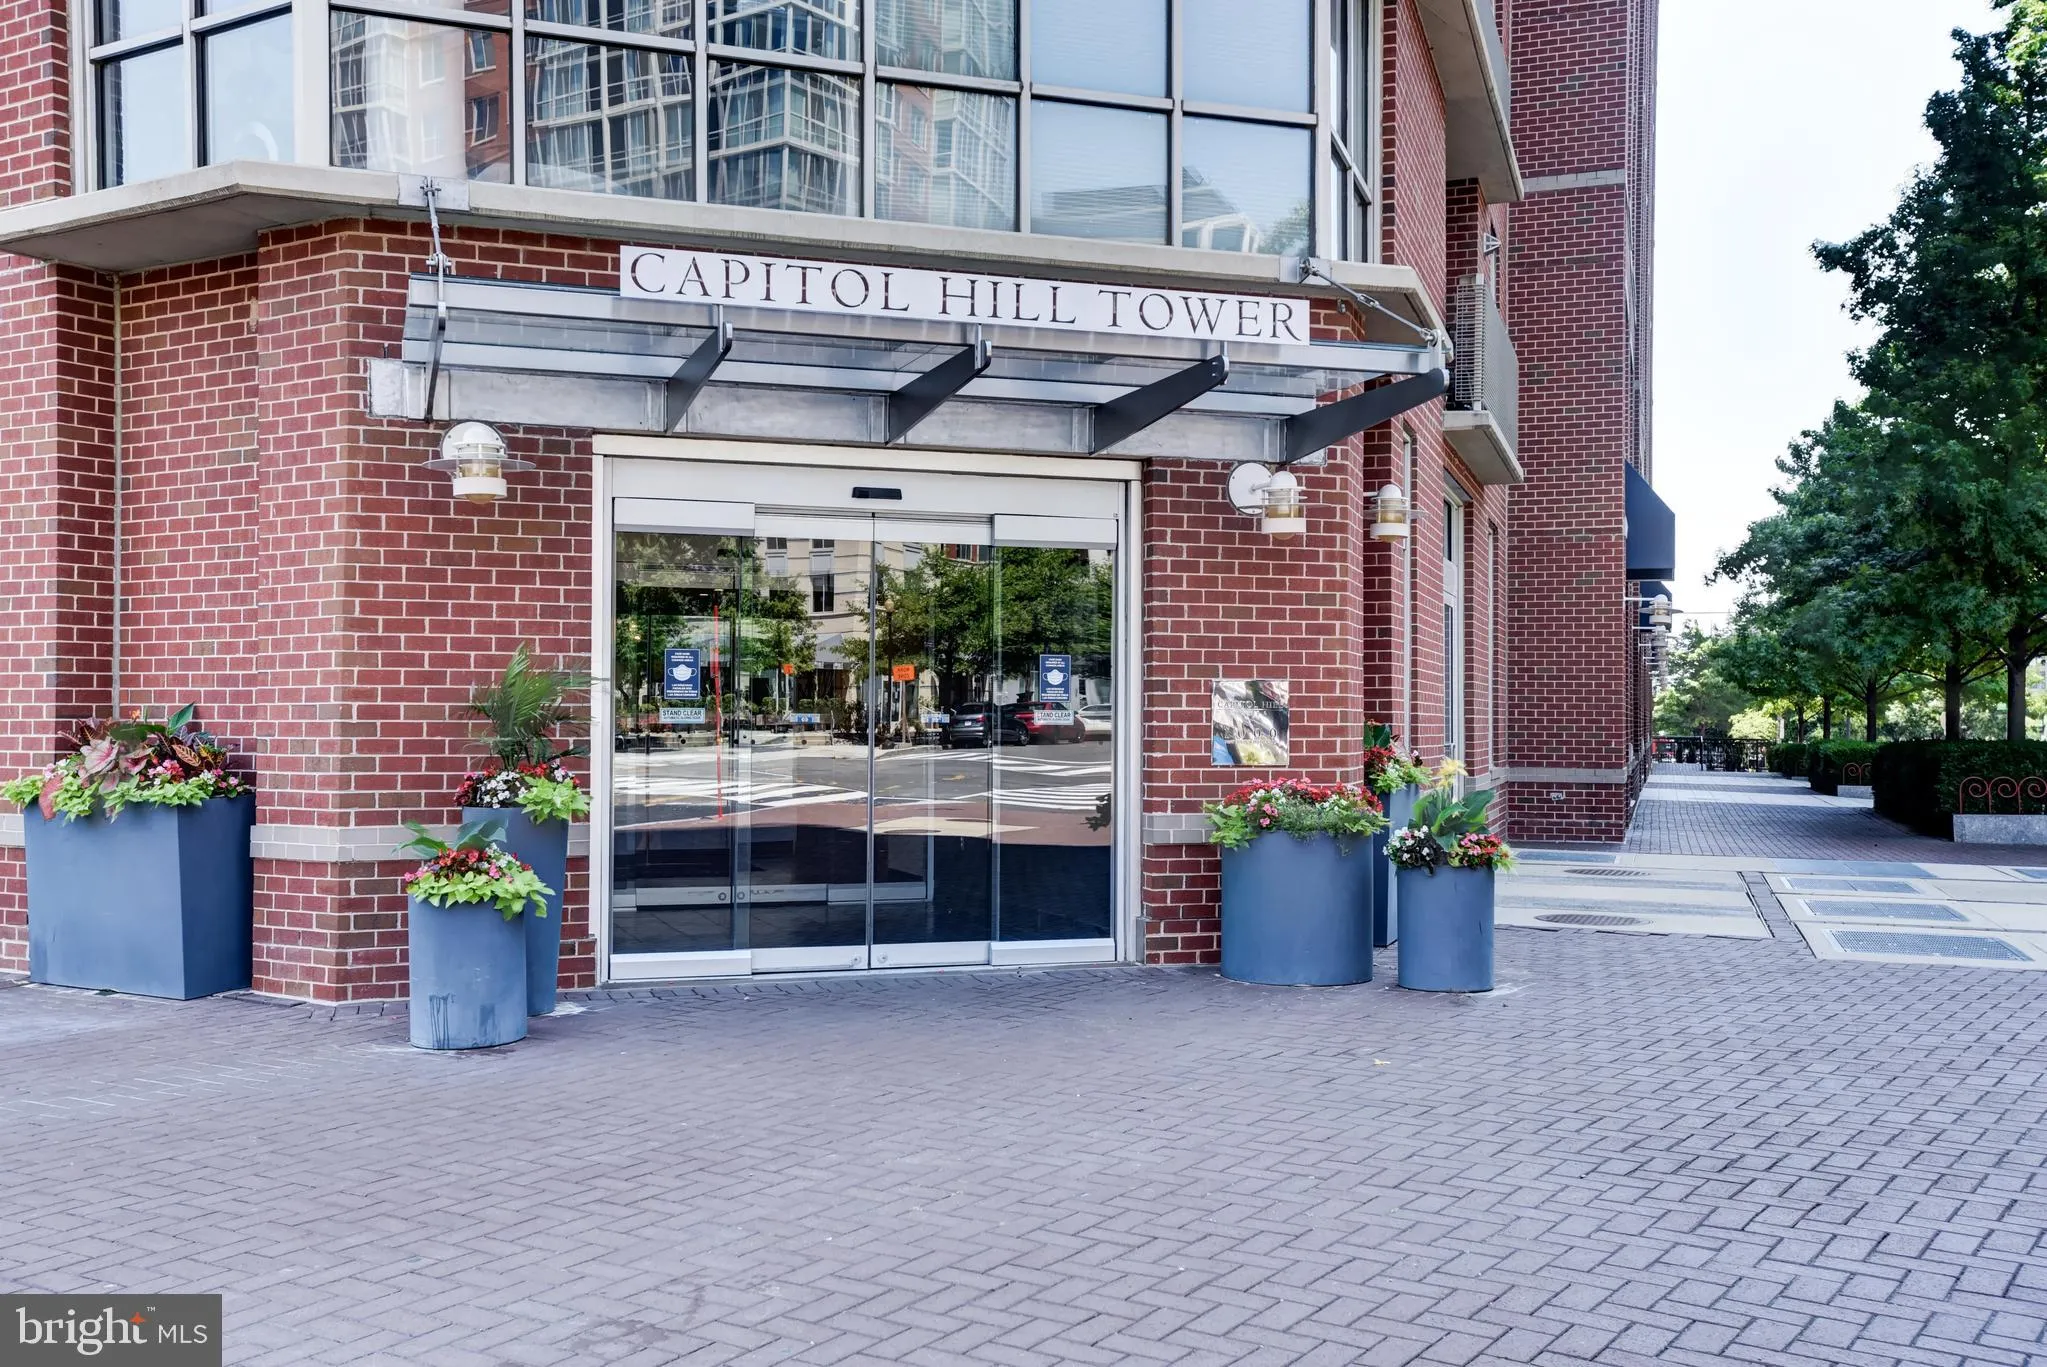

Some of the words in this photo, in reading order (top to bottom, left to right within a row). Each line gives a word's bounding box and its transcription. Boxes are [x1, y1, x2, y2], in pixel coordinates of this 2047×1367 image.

[630, 252, 910, 312] CAPITOL
[938, 276, 1077, 324] HILL
[1098, 289, 1303, 342] TOWER
[662, 709, 682, 717] STAND
[683, 709, 702, 717] CLEAR
